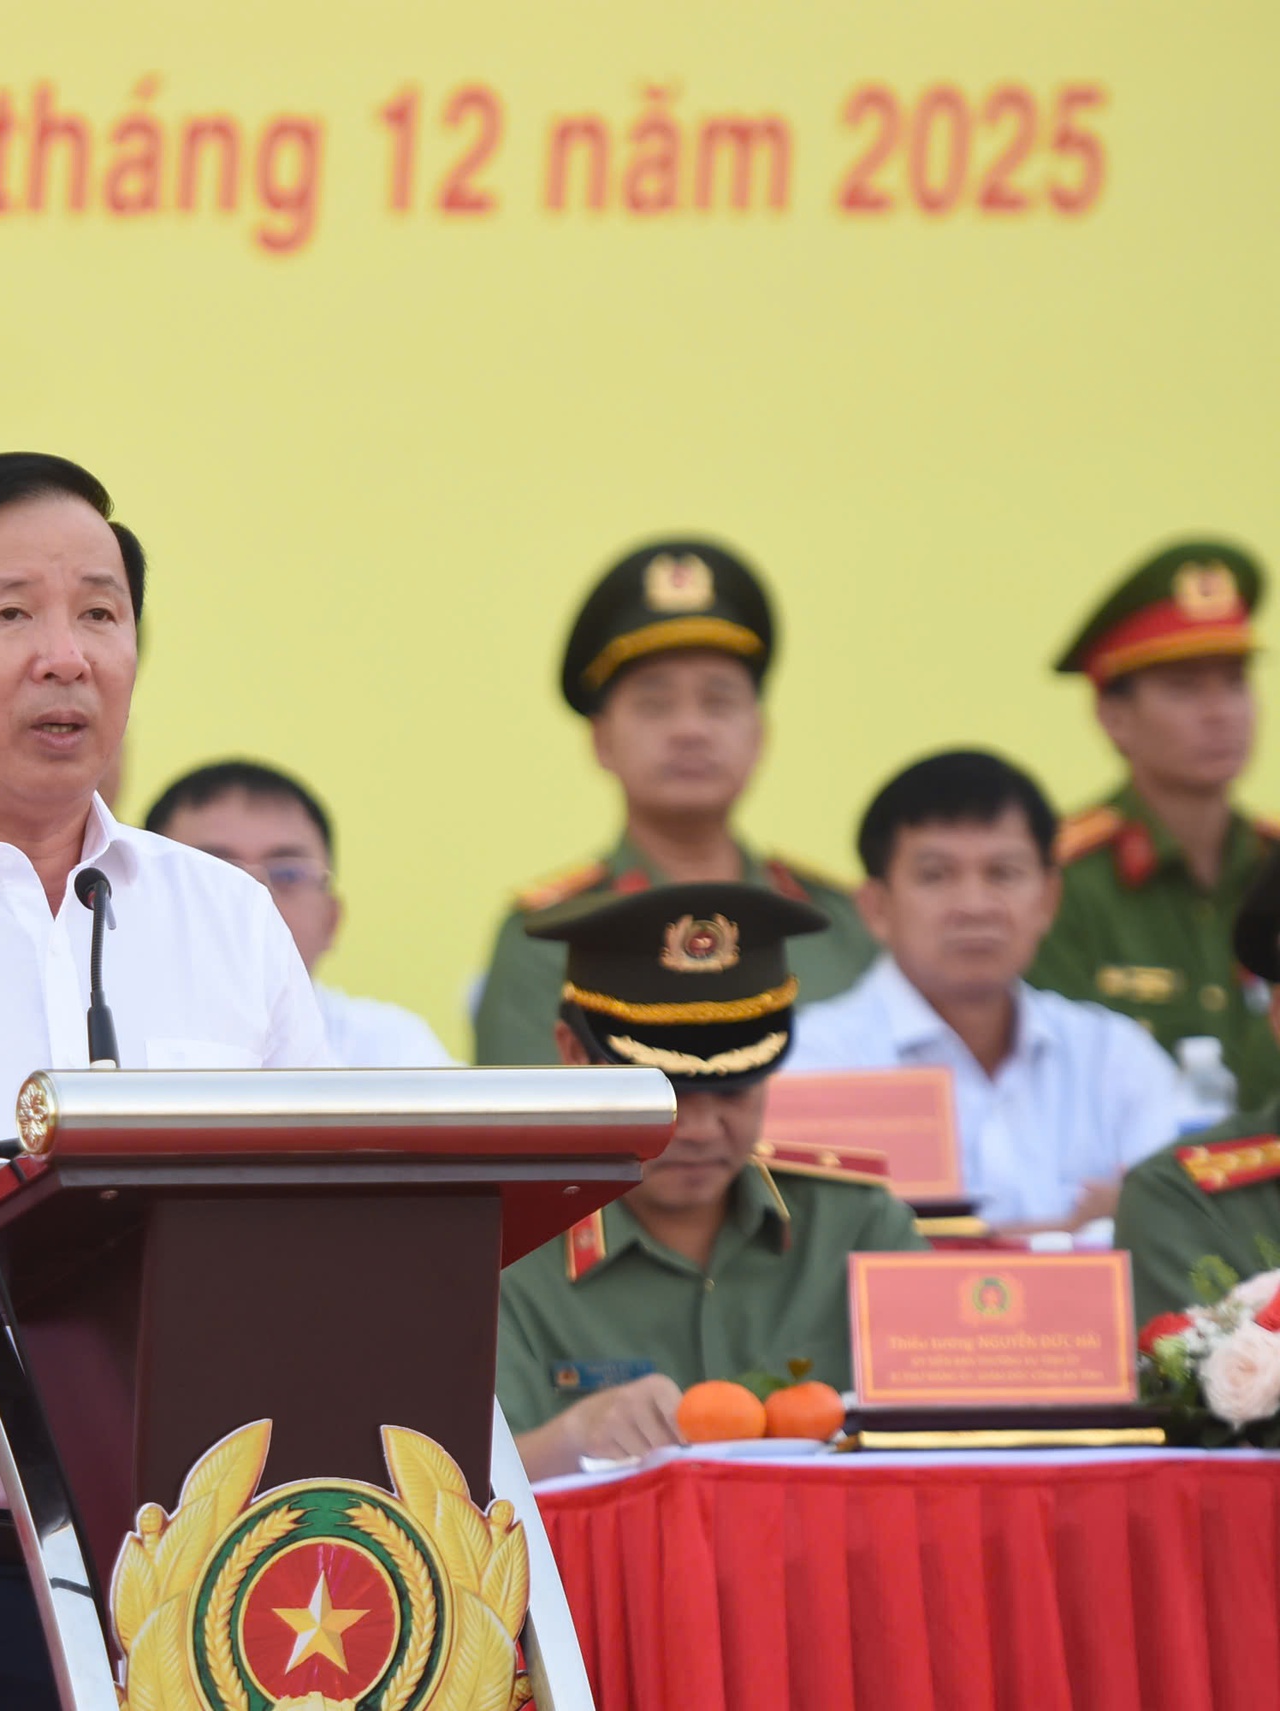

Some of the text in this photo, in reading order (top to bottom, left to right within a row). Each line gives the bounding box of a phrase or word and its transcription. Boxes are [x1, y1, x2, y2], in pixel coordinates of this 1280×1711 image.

[380, 85, 502, 216] 12
[545, 84, 792, 215] năm
[836, 84, 1110, 215] 2025
